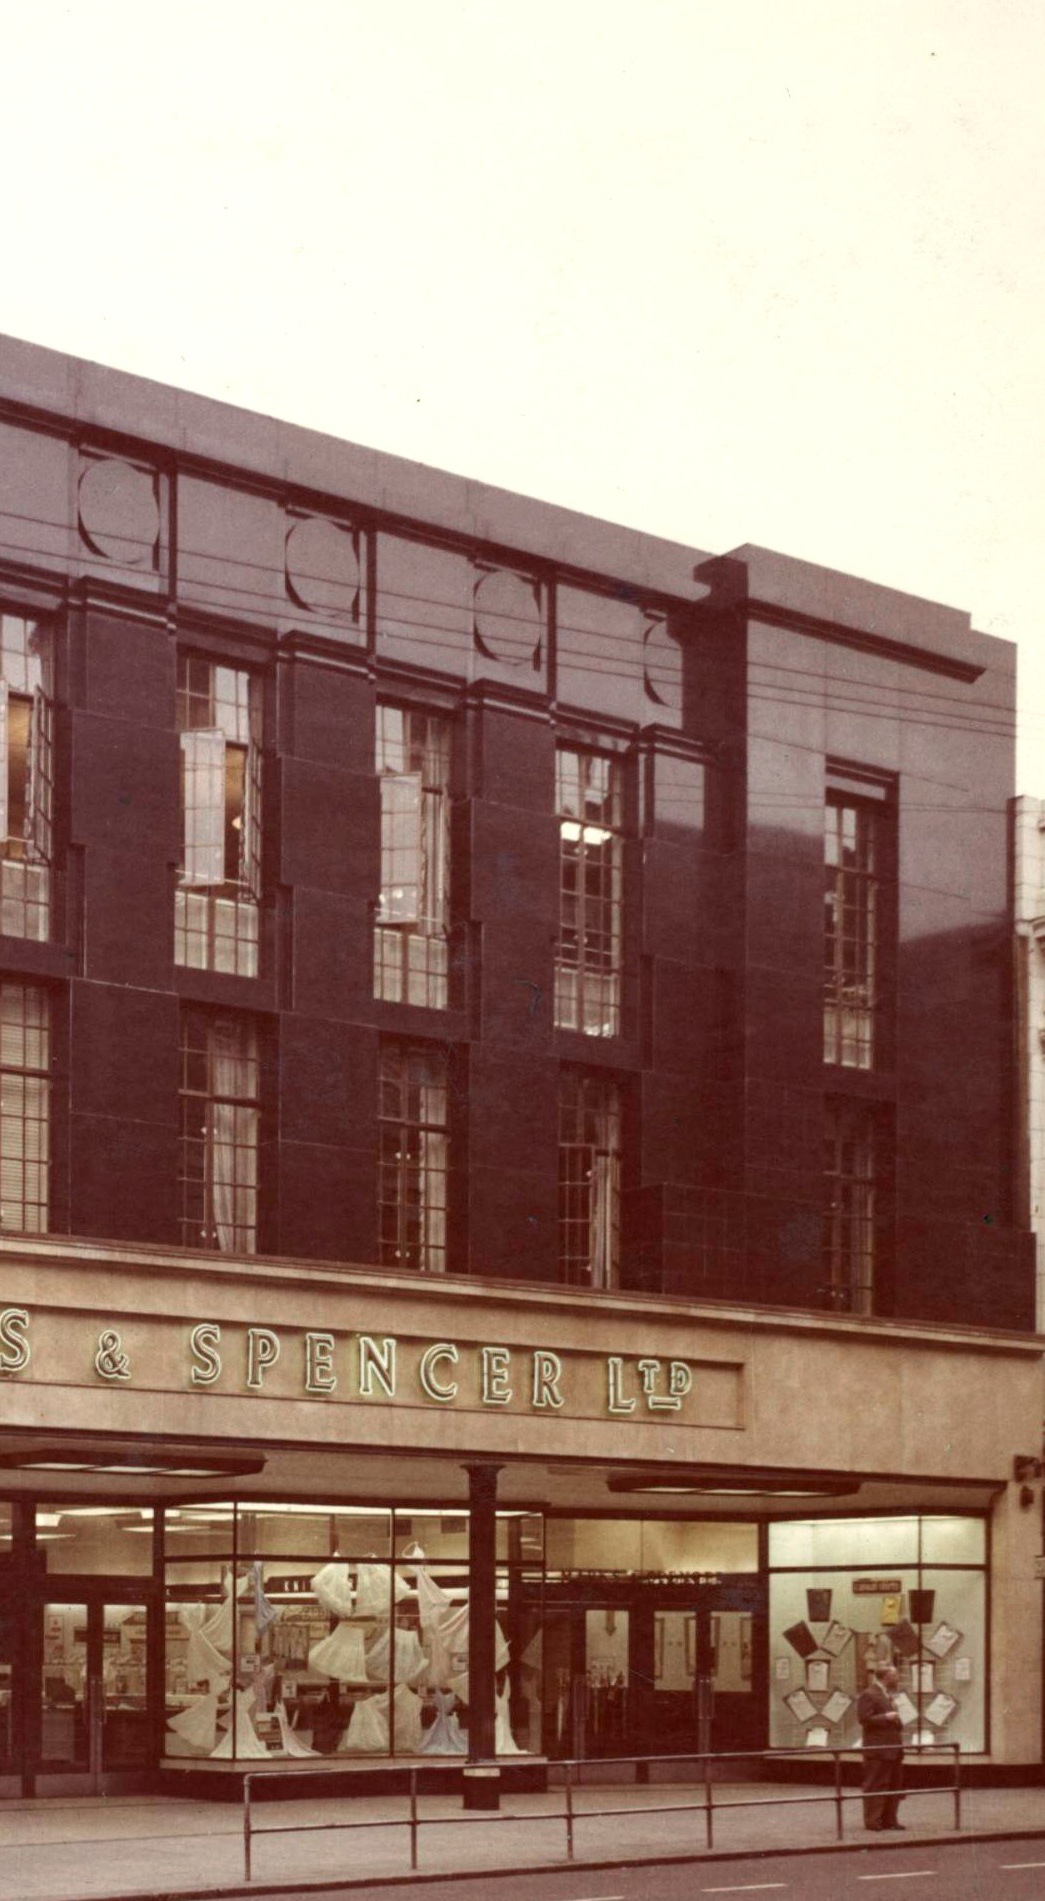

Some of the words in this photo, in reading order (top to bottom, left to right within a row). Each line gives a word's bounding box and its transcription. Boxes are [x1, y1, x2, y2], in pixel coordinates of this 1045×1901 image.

[95, 1330, 130, 1379] &
[190, 1324, 563, 1406] SPENCER
[607, 1357, 692, 1412] LTD
